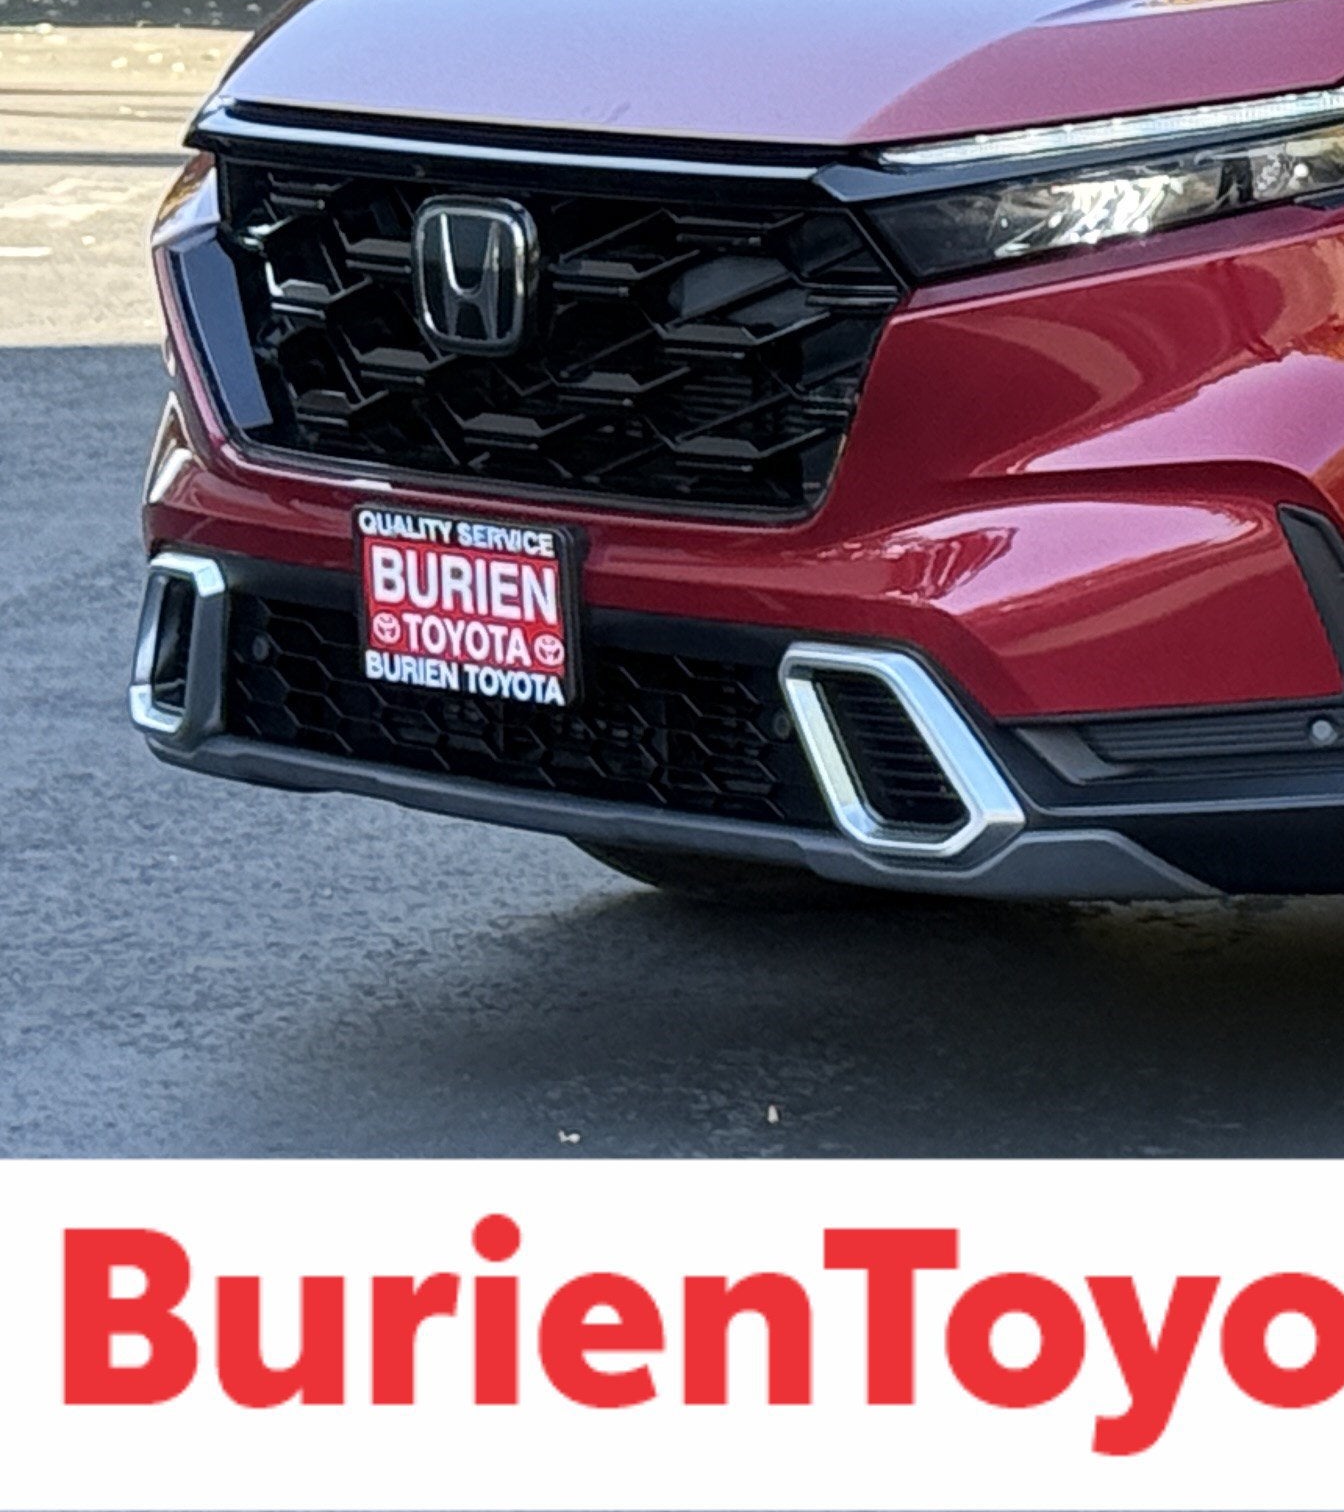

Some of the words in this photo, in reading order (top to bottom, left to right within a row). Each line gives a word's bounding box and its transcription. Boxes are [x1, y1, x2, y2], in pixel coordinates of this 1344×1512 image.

[358, 510, 452, 542] QUALITY
[456, 522, 555, 558] SERVICE
[370, 544, 559, 626] BURIEN
[401, 612, 533, 667] TOYOTA
[365, 650, 460, 692] BURIEN
[463, 663, 567, 707] TOYOTA
